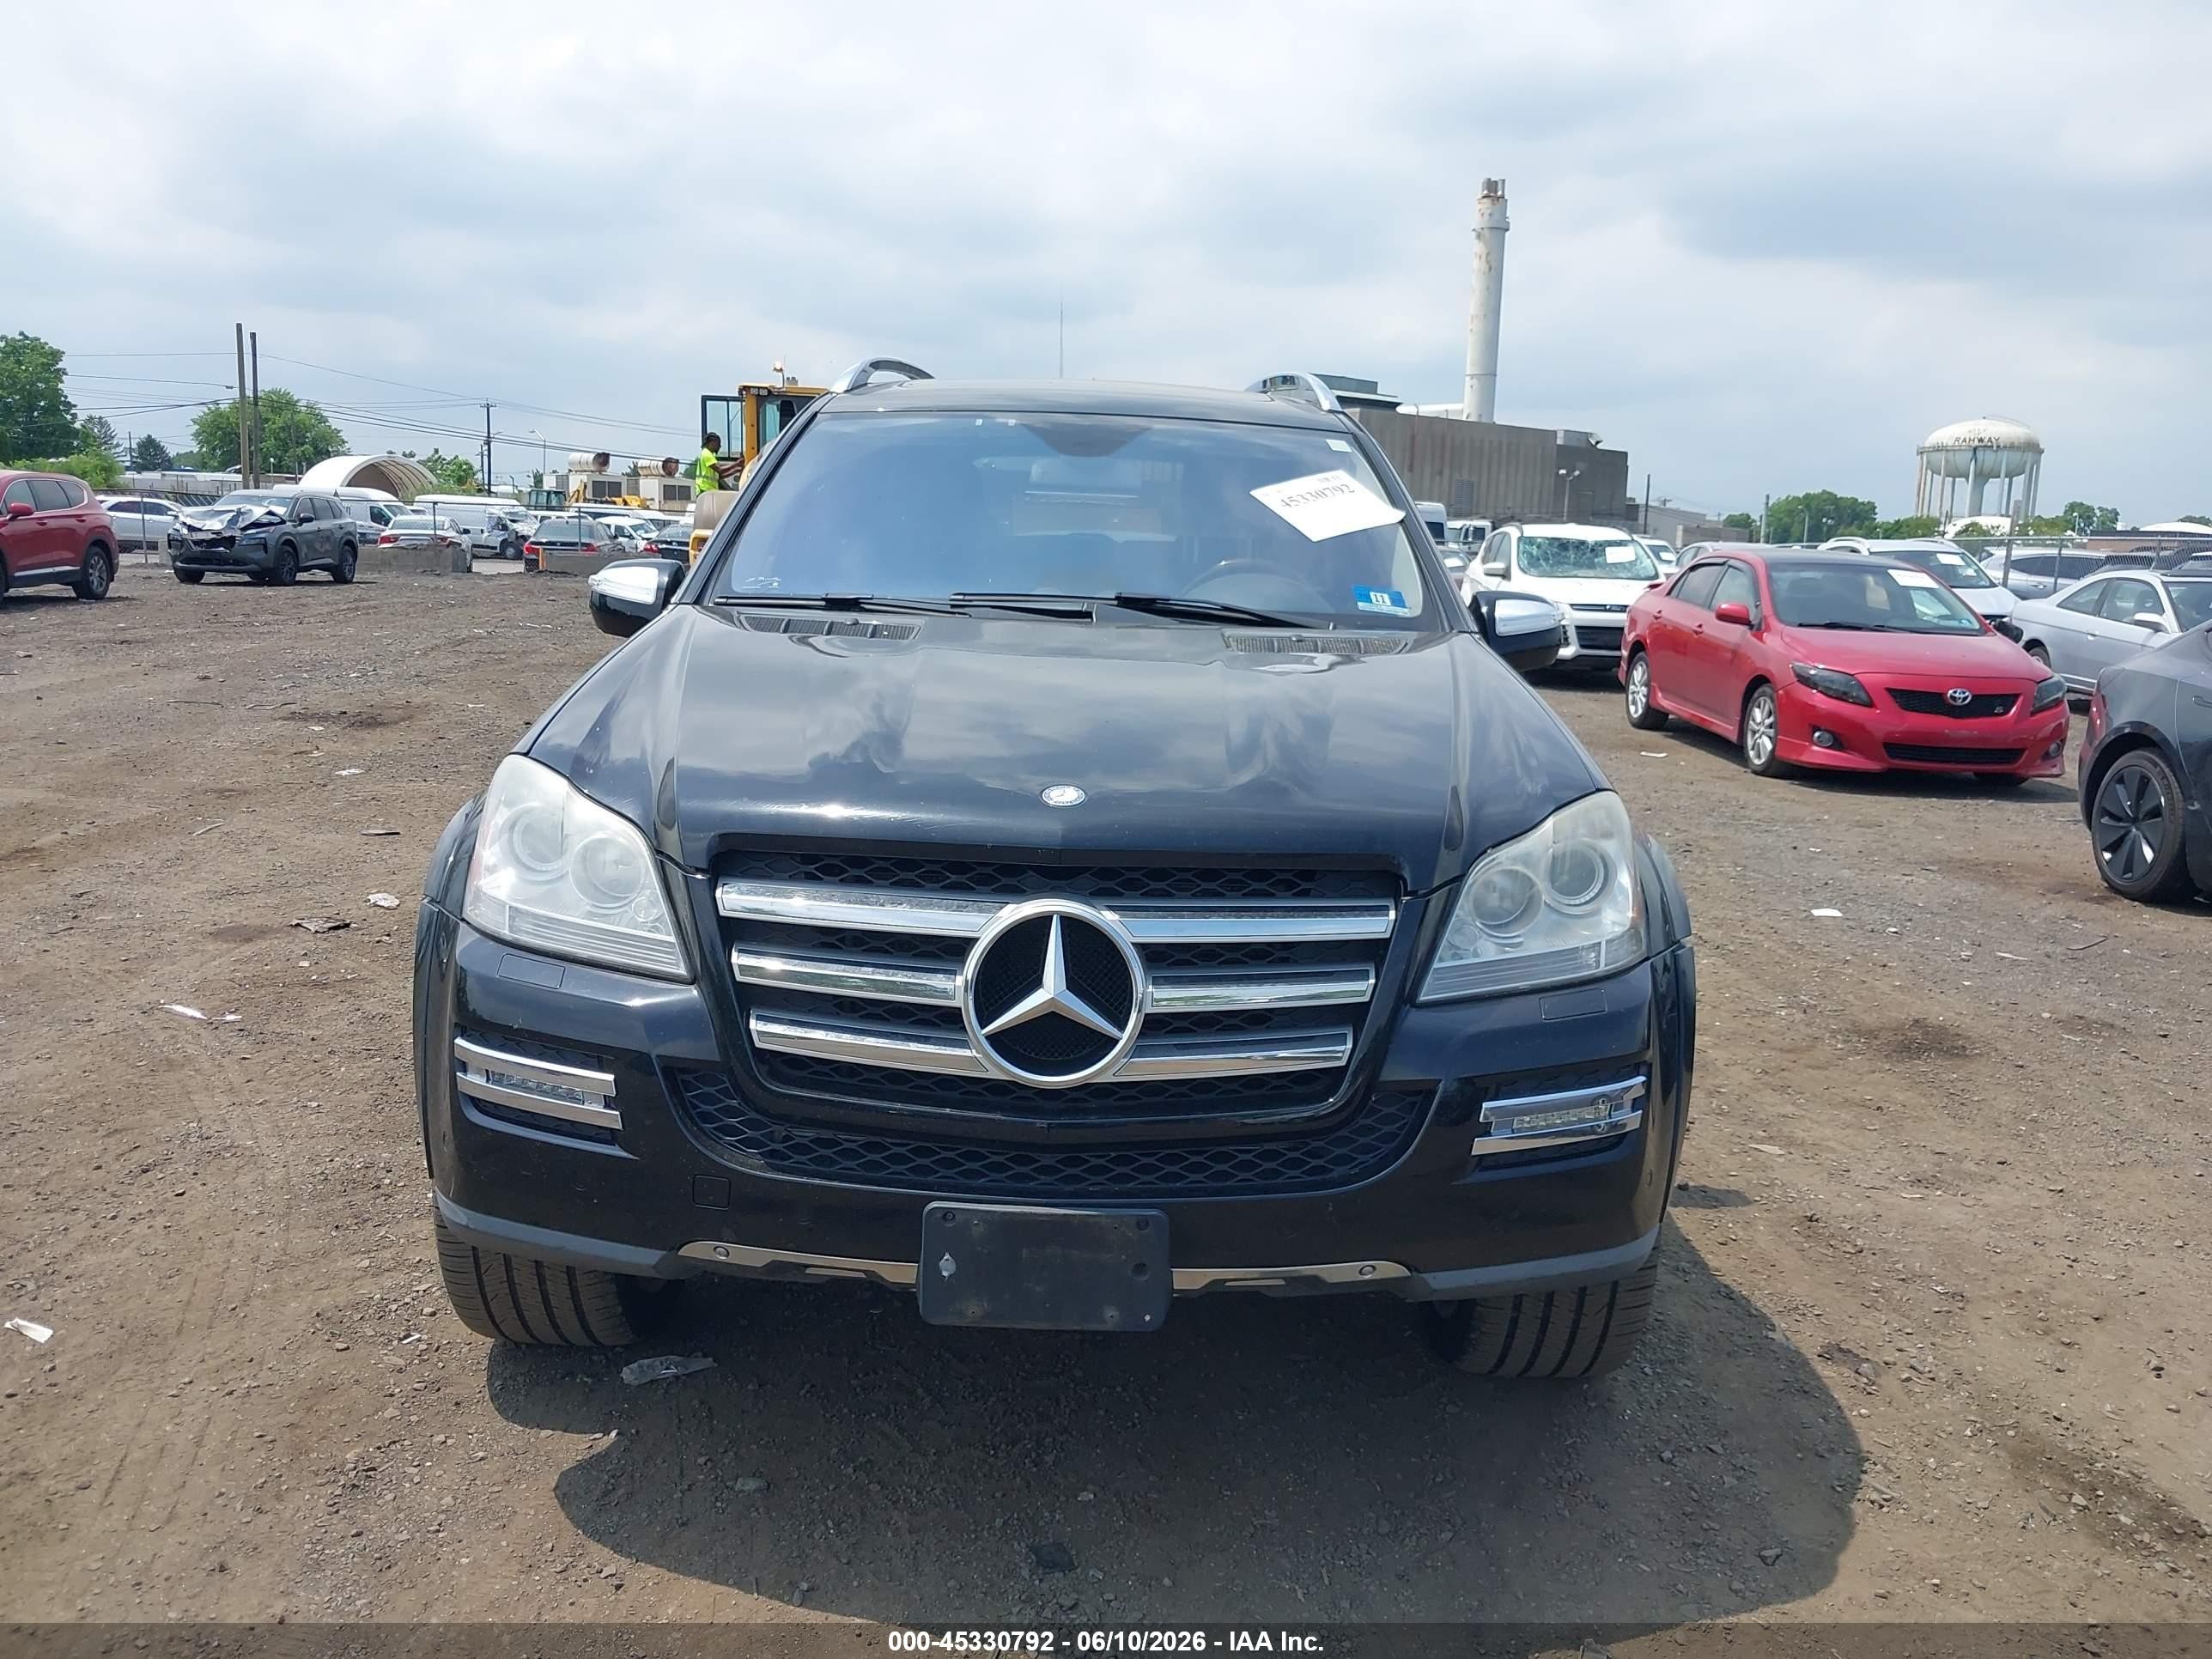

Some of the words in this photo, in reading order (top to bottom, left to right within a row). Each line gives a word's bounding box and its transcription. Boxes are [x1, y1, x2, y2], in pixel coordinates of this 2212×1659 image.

[1954, 436, 2000, 445] RAHWAY
[1280, 483, 1356, 508] 45330792
[1373, 593, 1387, 605] 11
